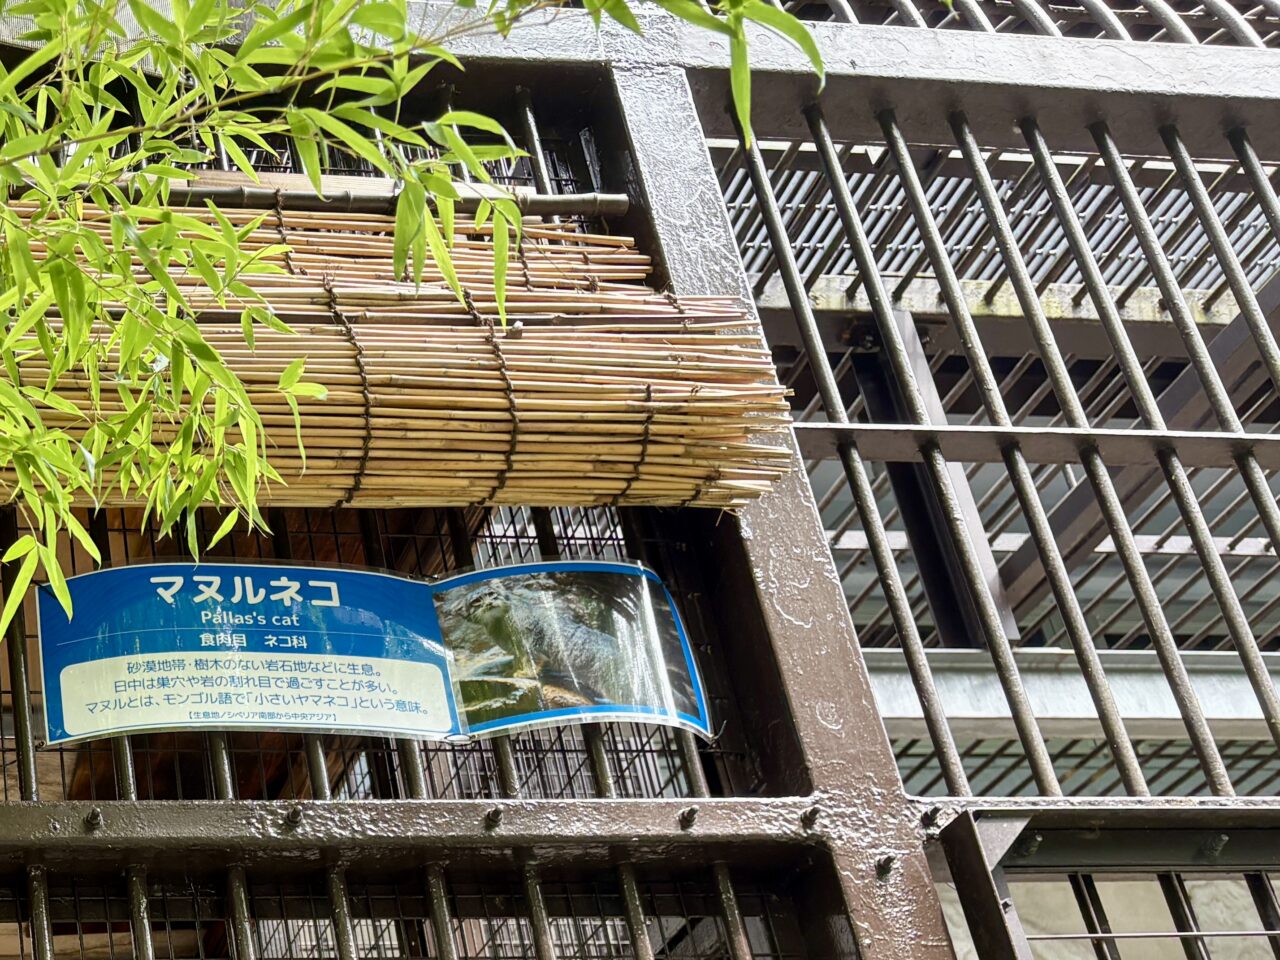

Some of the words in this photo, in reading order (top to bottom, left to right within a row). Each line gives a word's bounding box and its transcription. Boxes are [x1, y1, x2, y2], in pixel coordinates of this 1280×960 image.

[150, 576, 340, 607] マヌルネコ
[201, 610, 267, 625] Pallas's
[272, 613, 300, 626] cat
[199, 633, 247, 647] 食肉目
[264, 634, 308, 649] ネコ科
[114, 675, 398, 695] 日中は巣穴や岩の割れ目で過ごすことが多い。
[85, 692, 428, 715] マヌルとは、モンゴル語で「小さいヤマネコ」という意味。
